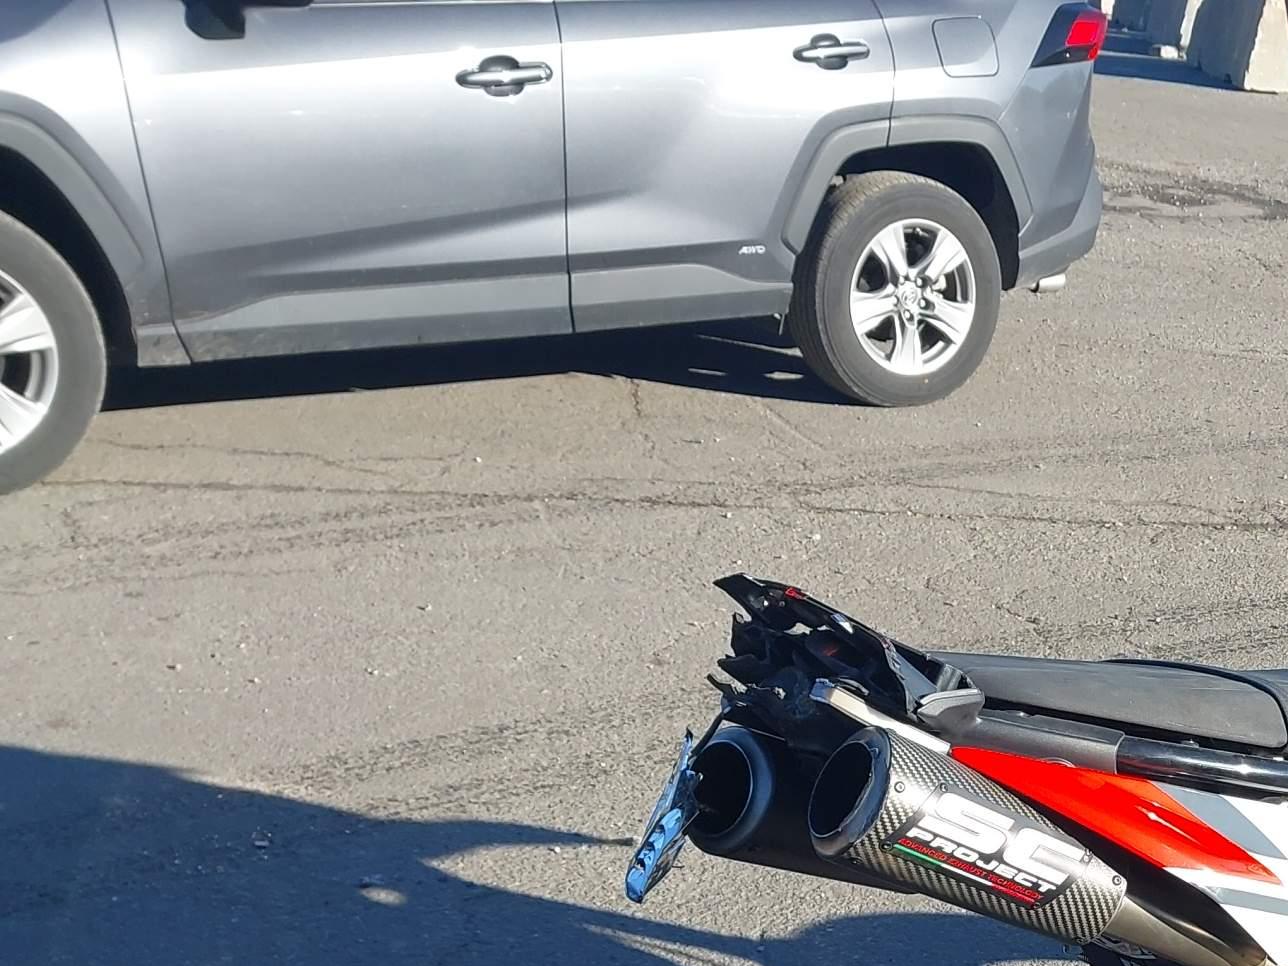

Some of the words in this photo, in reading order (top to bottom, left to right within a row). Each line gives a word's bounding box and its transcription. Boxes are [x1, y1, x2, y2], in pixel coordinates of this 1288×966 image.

[897, 838, 948, 862] ADVANCED
[944, 857, 988, 878] EXHAUST
[905, 826, 1058, 894] PROJECT
[917, 792, 1086, 885] SC
